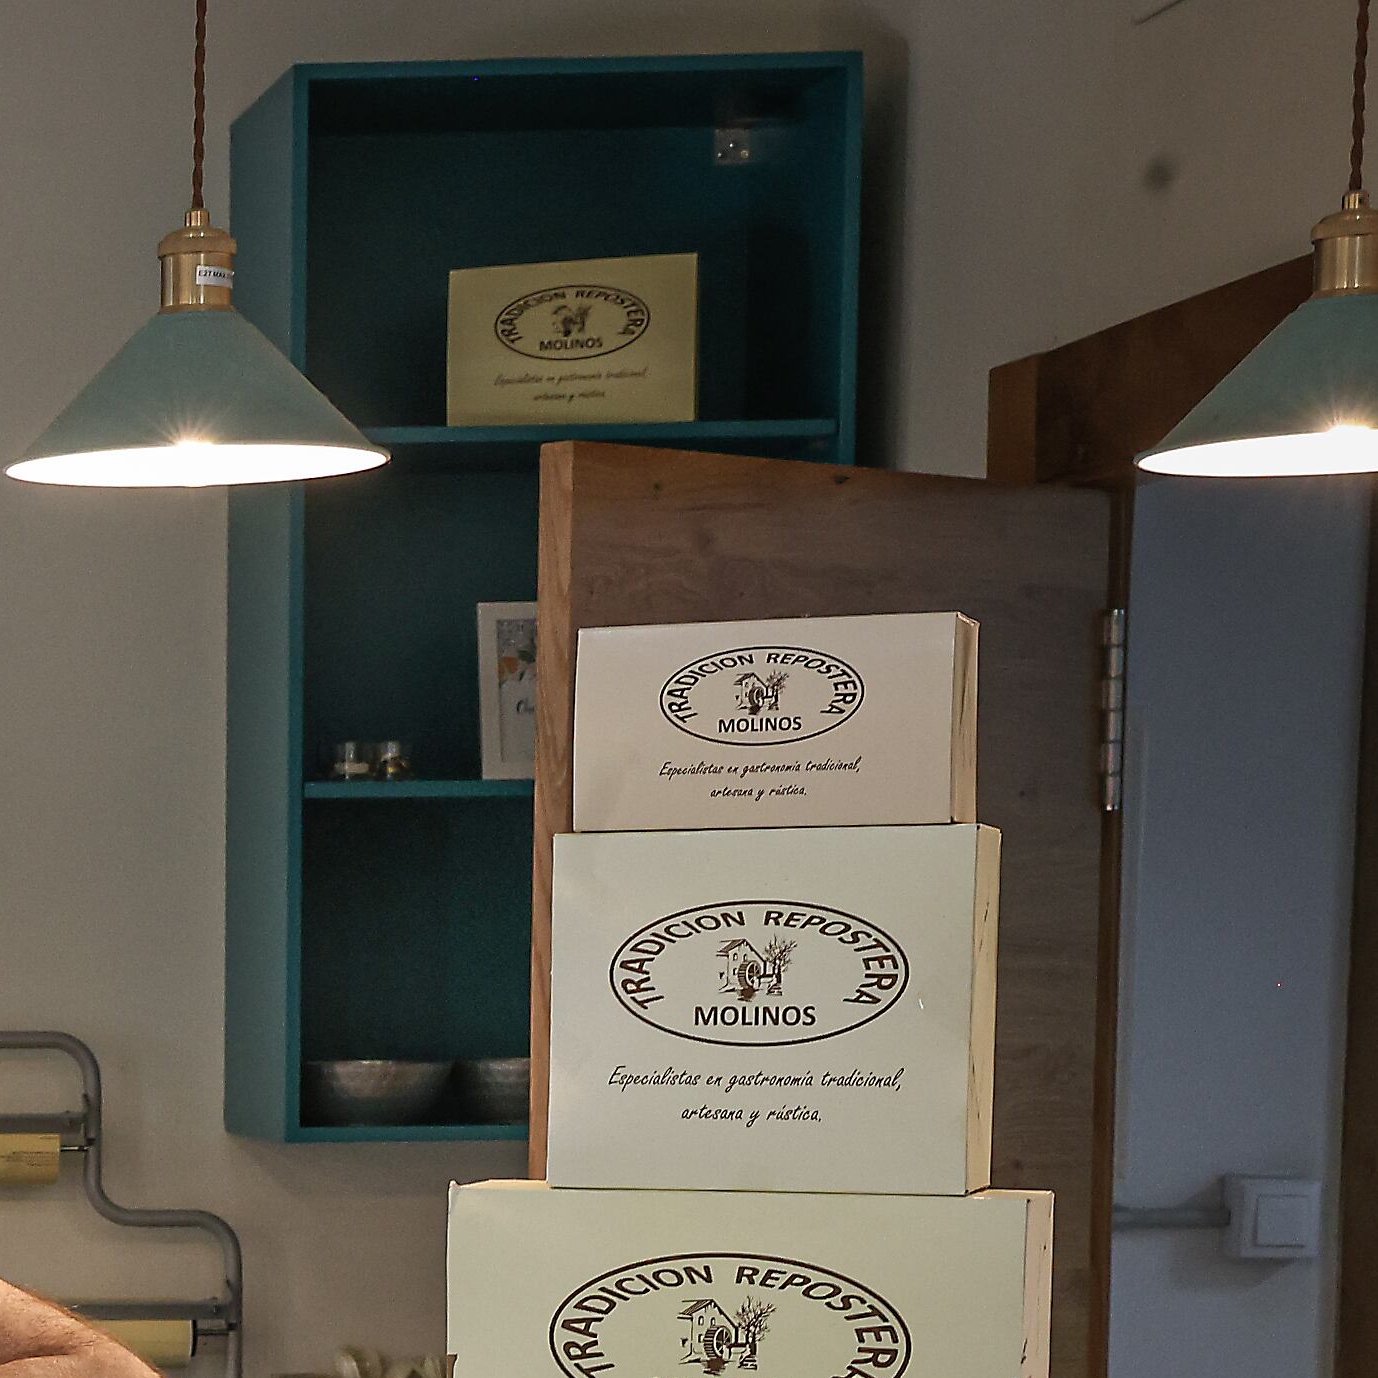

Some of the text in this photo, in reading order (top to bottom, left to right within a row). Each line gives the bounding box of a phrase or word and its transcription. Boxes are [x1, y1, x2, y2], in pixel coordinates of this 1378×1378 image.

[500, 290, 645, 344] TRADICION REPOSTERA
[539, 337, 603, 351] MOLINOS
[666, 652, 857, 724] TRADICION REPOSTERA
[718, 716, 802, 734] MOLINOS
[659, 756, 862, 780] Especialistas en gastronomía tradicional,
[710, 785, 753, 798] artesana
[756, 788, 765, 801] y
[620, 909, 899, 1010] TRADICION REPOSTERA
[694, 1005, 816, 1026] MOLINOS
[608, 1065, 907, 1093] Especialistas en gastronomía tradicional,
[681, 1104, 822, 1127] artesana y rústica.
